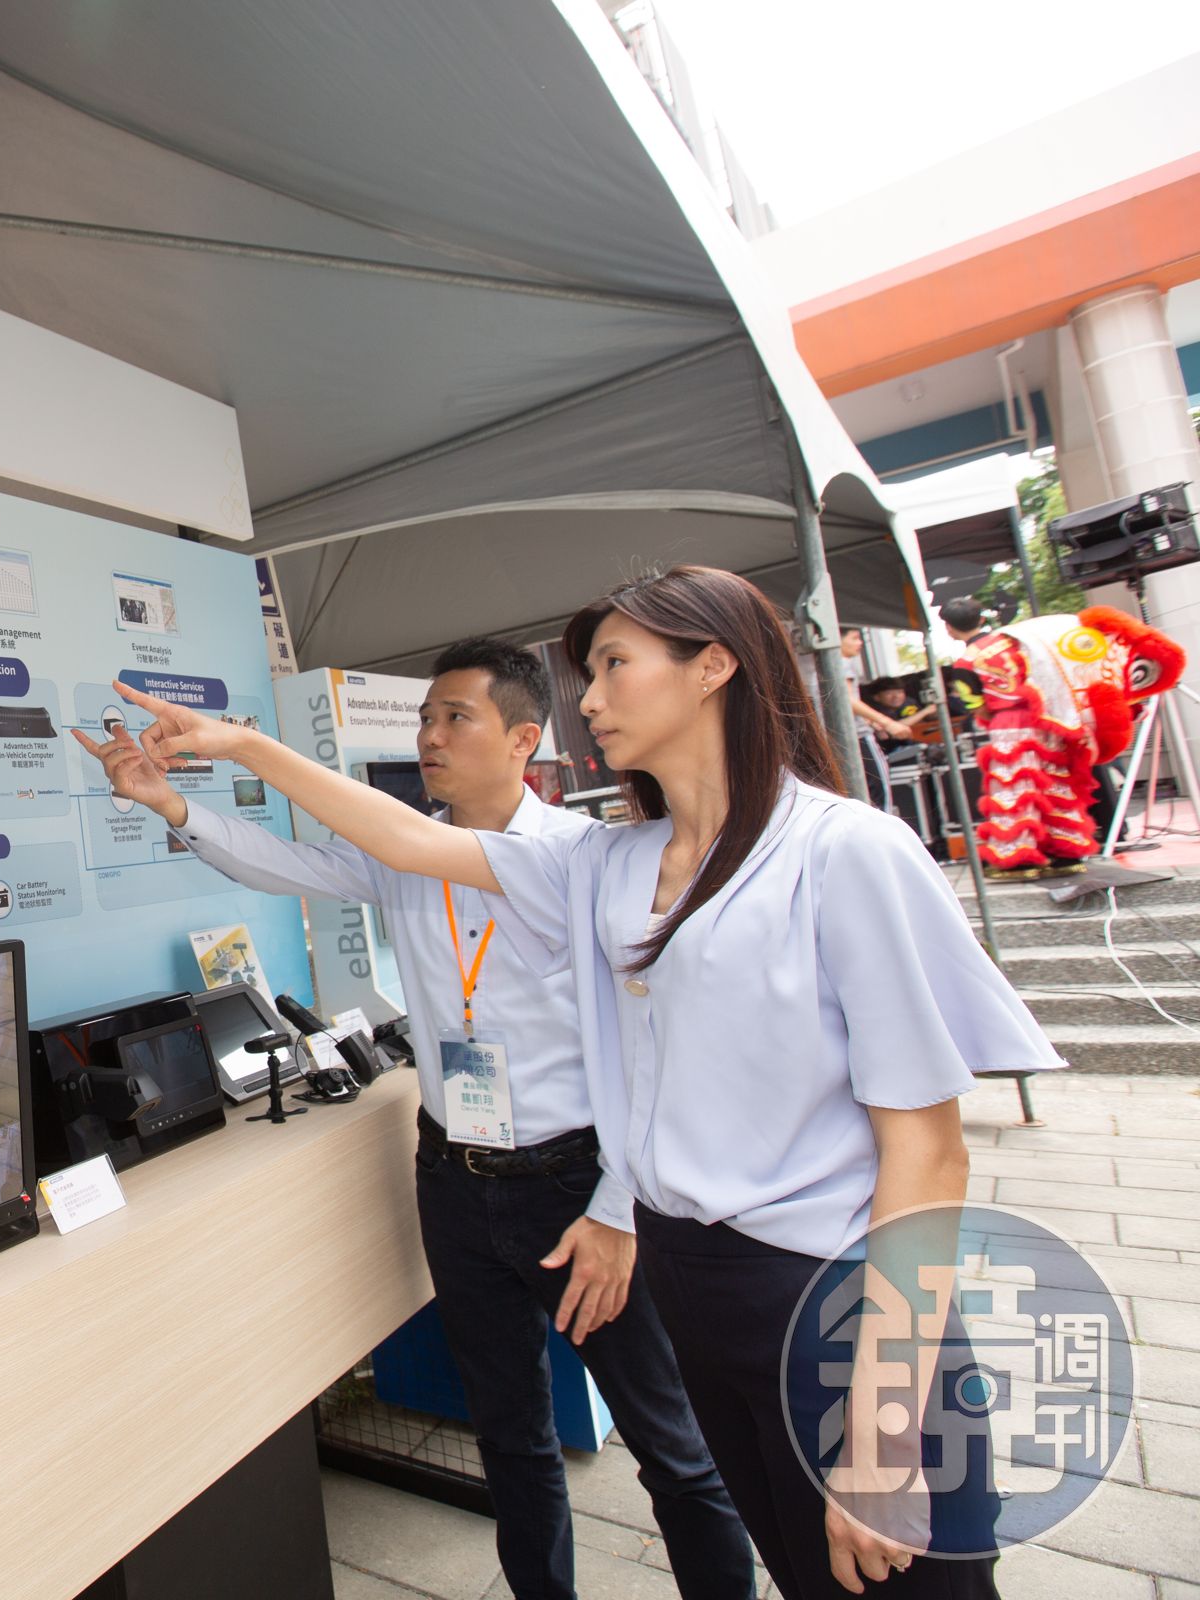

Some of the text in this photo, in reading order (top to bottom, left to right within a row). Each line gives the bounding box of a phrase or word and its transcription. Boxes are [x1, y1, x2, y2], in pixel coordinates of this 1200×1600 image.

[131, 642, 172, 656] Event Analysis
[144, 677, 205, 692] Interactive Services
[348, 697, 377, 710] Advantech
[391, 701, 404, 713] eBus
[350, 716, 367, 726] Ensure
[368, 717, 385, 728] Driving
[385, 717, 400, 728] Safety
[0, 751, 54, 760] In-Vehicle Computer
[111, 824, 143, 834] Signage Player
[16, 881, 48, 890] Car Battery
[17, 888, 66, 900] Status Monitoring
[338, 900, 371, 979] eBu
[471, 1125, 488, 1136] T4
